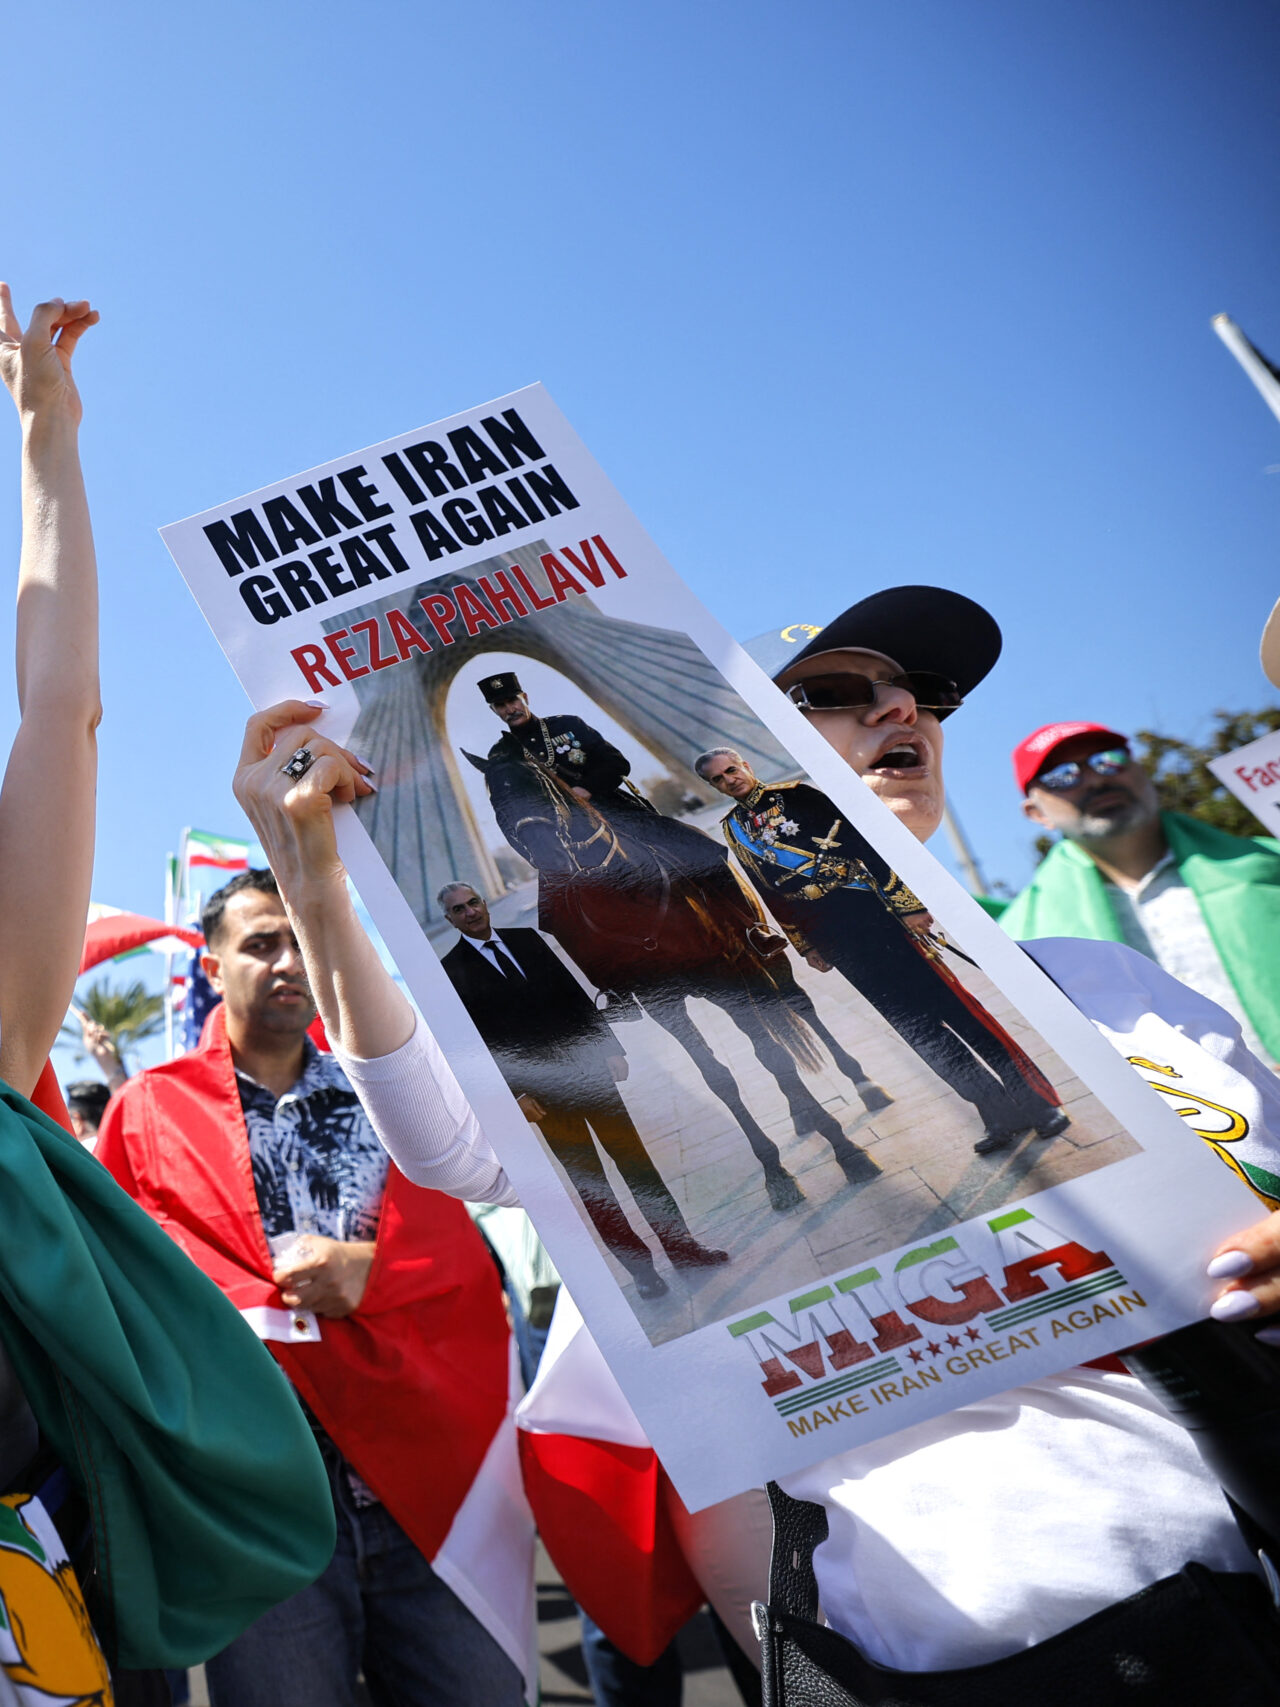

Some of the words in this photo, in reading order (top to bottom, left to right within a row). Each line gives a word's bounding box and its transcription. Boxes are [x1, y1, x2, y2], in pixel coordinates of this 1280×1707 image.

[202, 464, 395, 578] MAKE
[380, 407, 547, 506] IRAN
[239, 522, 411, 626] GREAT
[409, 463, 581, 562] AGAIN
[290, 612, 433, 695] REZA
[419, 533, 628, 646] PAHLAVI
[1233, 754, 1280, 793] Fac
[727, 1207, 1116, 1398] MIGA
[786, 1393, 870, 1439] MAKE
[871, 1365, 943, 1406] IRAN
[945, 1326, 1041, 1376] GREAT
[1050, 1289, 1148, 1339] AGAIN
